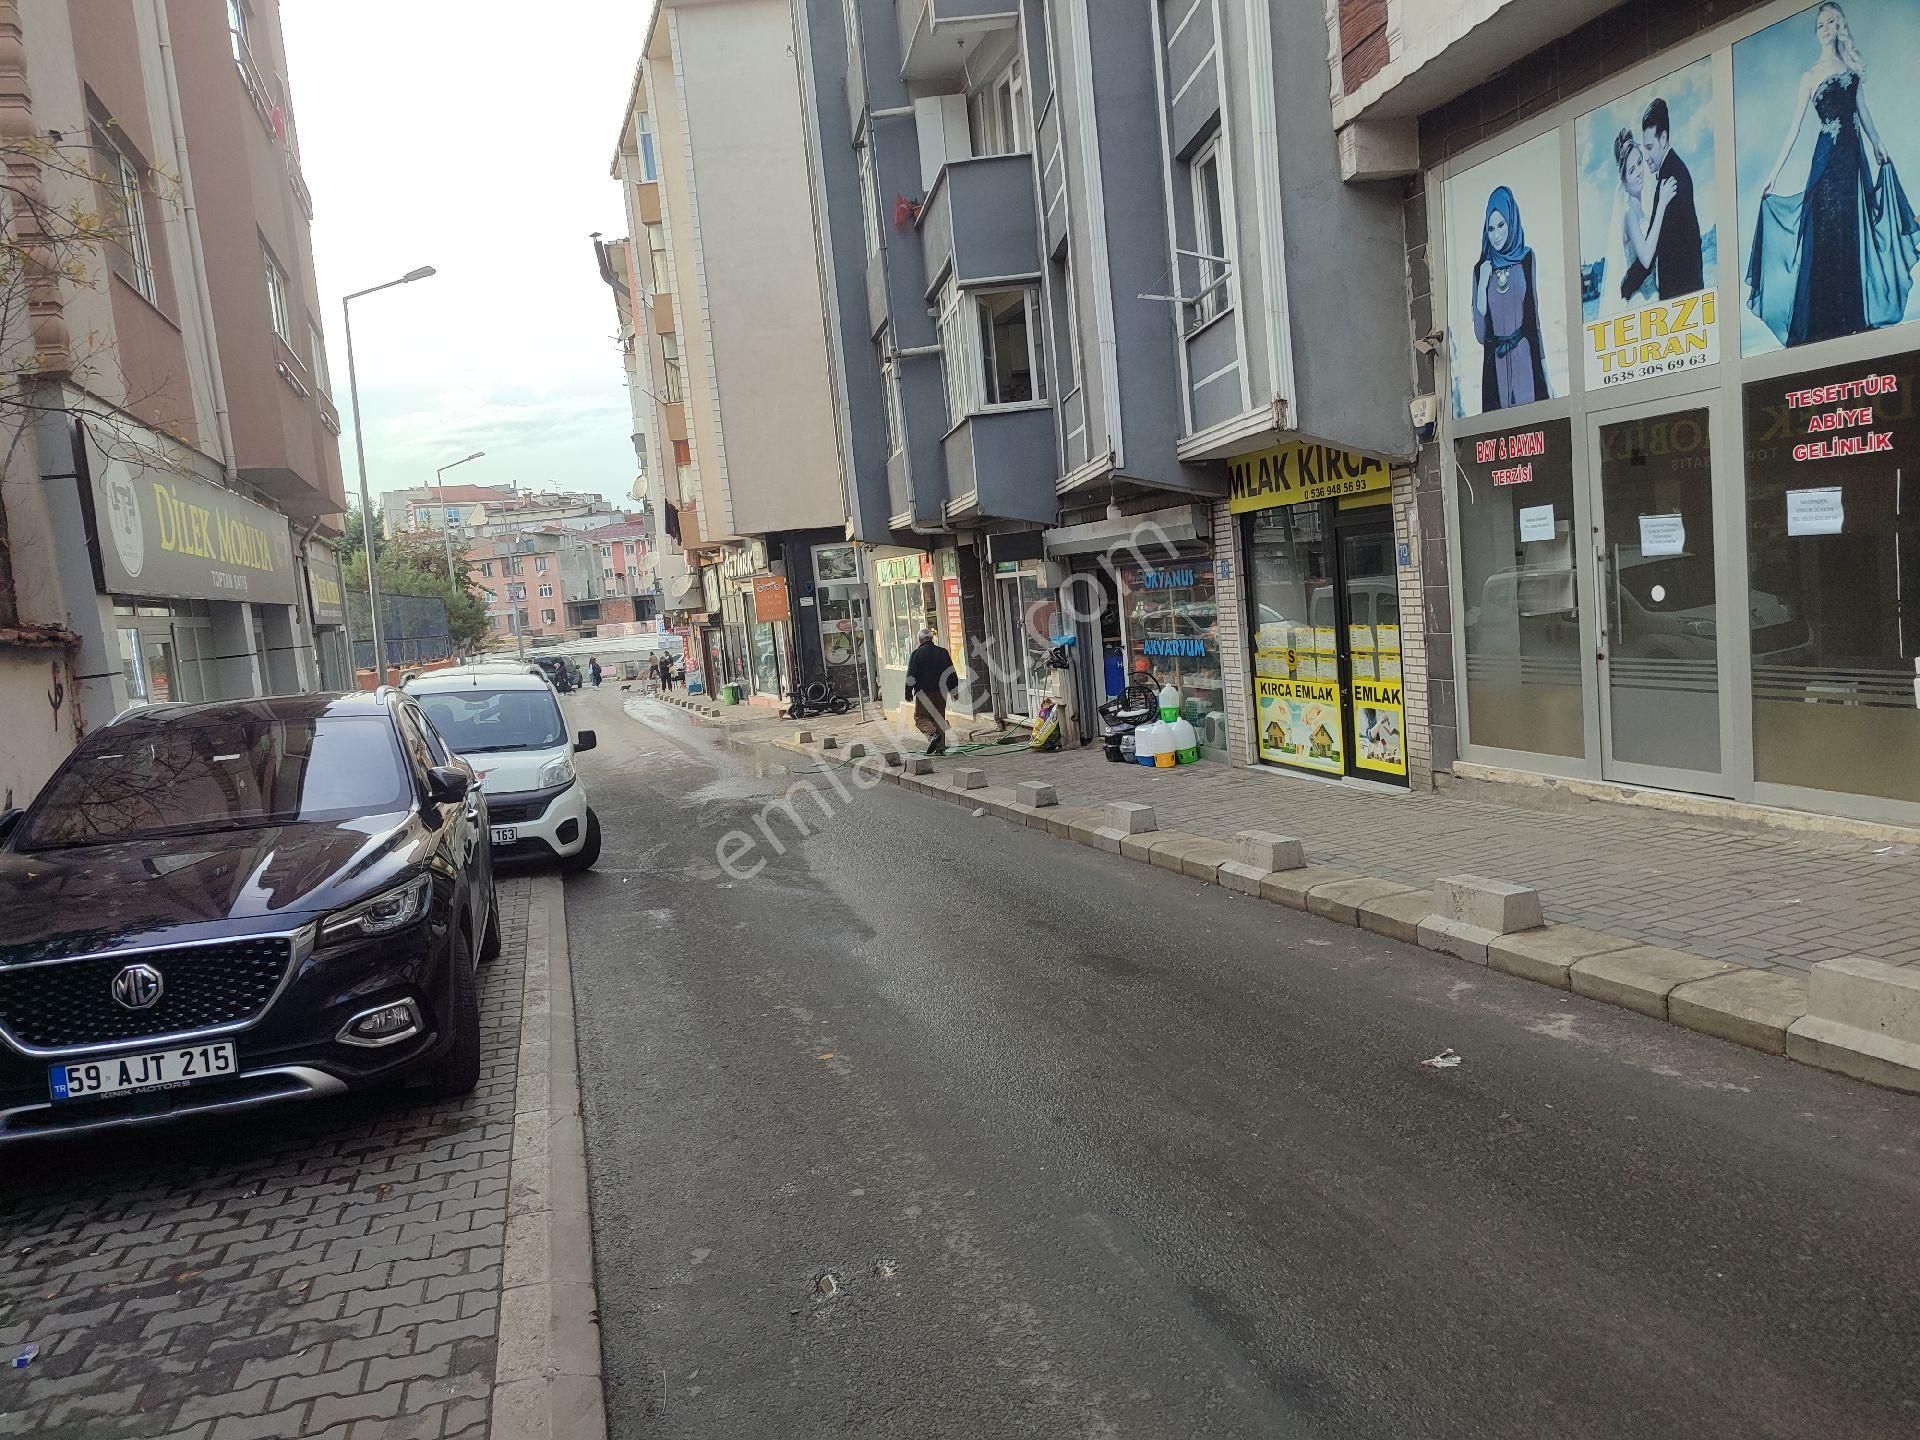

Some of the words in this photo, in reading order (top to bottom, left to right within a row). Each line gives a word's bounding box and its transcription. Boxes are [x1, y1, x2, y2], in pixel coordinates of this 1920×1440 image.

[1597, 329, 1708, 373] TURAN
[1603, 370, 1635, 385] 0538
[1638, 363, 1664, 377] 308
[1667, 358, 1685, 371] 69
[1688, 353, 1707, 366] 63
[1785, 374, 1898, 408] TESETTÜR
[1808, 407, 1873, 433] ABİYE
[1476, 439, 1497, 463] BAY
[1499, 437, 1507, 460] &
[1509, 431, 1544, 458] BAYAN
[1793, 431, 1894, 461] GELİNLİK
[1229, 452, 1291, 499] MLAK
[1304, 490, 1309, 500] 0
[1310, 486, 1325, 498] 536
[1326, 482, 1342, 496] 948
[1343, 481, 1354, 493] 56
[1355, 479, 1367, 491] 93
[1492, 462, 1533, 486] TERZİSİ
[153, 483, 217, 560] DİLEK
[215, 506, 274, 572] MOBİLYA
[1260, 682, 1293, 698] KIRCA
[1295, 684, 1334, 701] EMLAK
[1354, 685, 1402, 705] EMLAK
[496, 829, 515, 841] 163
[116, 968, 158, 1006] MG
[54, 1085, 66, 1093] TR
[67, 1065, 101, 1093] 59
[118, 1055, 165, 1086] AJT
[179, 1046, 230, 1077] 215
[100, 1087, 133, 1099] KINIK
[135, 1080, 191, 1094] MOTORS
